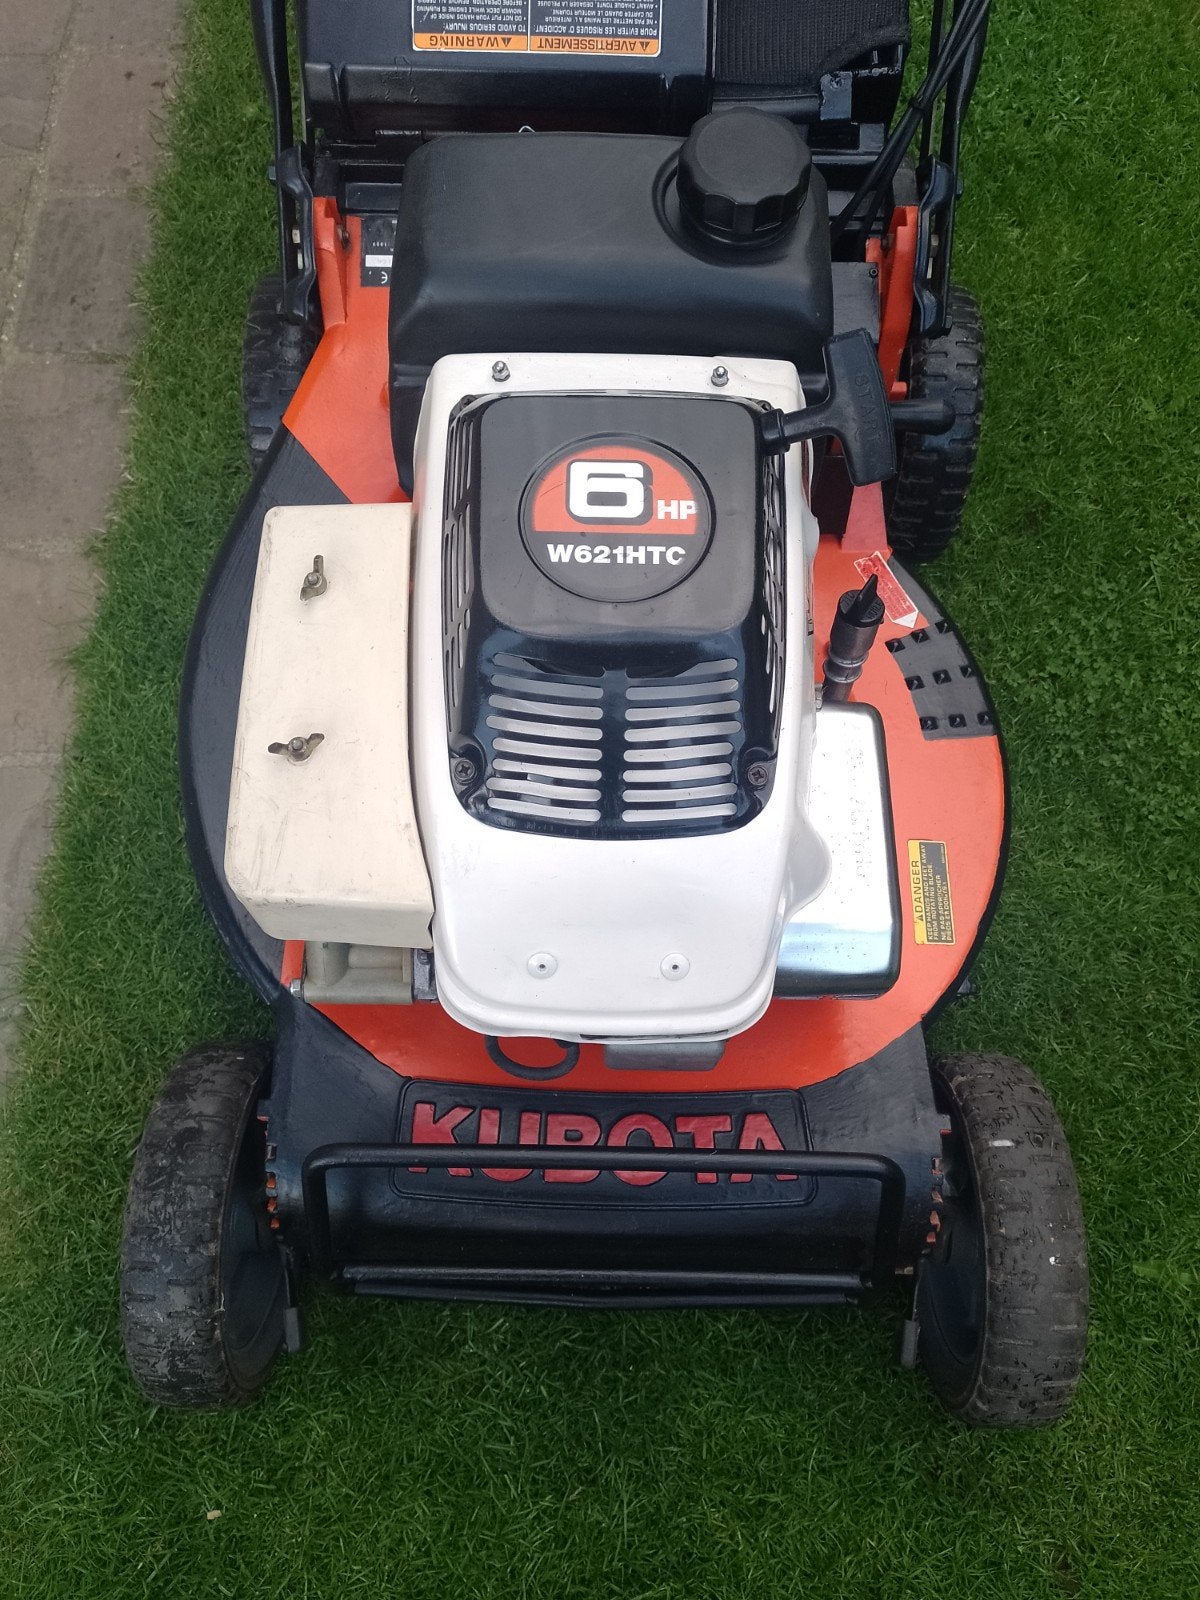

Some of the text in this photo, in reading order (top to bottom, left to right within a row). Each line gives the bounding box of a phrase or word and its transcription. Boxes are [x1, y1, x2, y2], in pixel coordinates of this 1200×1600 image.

[429, 36, 499, 47] WARNING
[537, 38, 636, 51] AVERTISSEMENT
[576, 25, 603, 34] RISQUES
[854, 375, 882, 442] START
[569, 460, 697, 520] 6 HP
[546, 544, 686, 566] W621HTC
[911, 860, 923, 913] DANGER
[406, 1101, 799, 1187] KUBOTA
